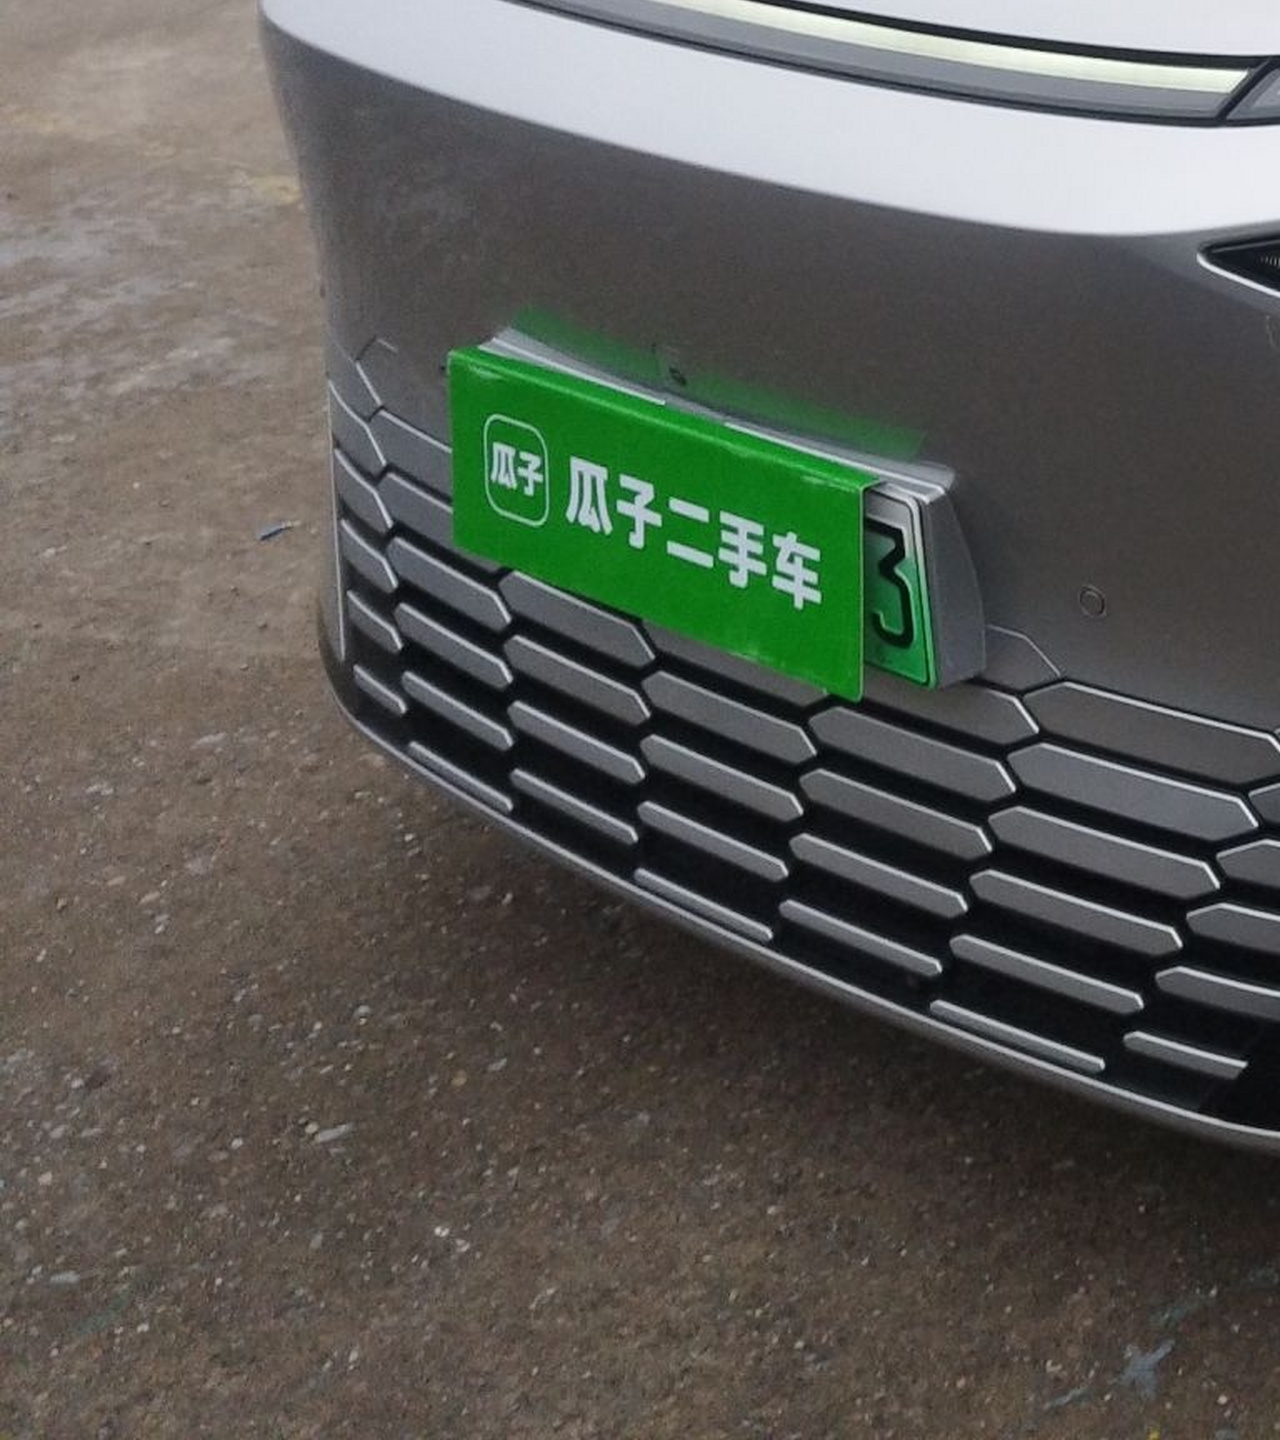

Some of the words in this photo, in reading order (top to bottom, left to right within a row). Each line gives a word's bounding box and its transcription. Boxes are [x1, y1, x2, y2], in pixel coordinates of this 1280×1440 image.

[490, 442, 543, 496] 瓜子
[566, 456, 822, 610] 瓜子二手车
